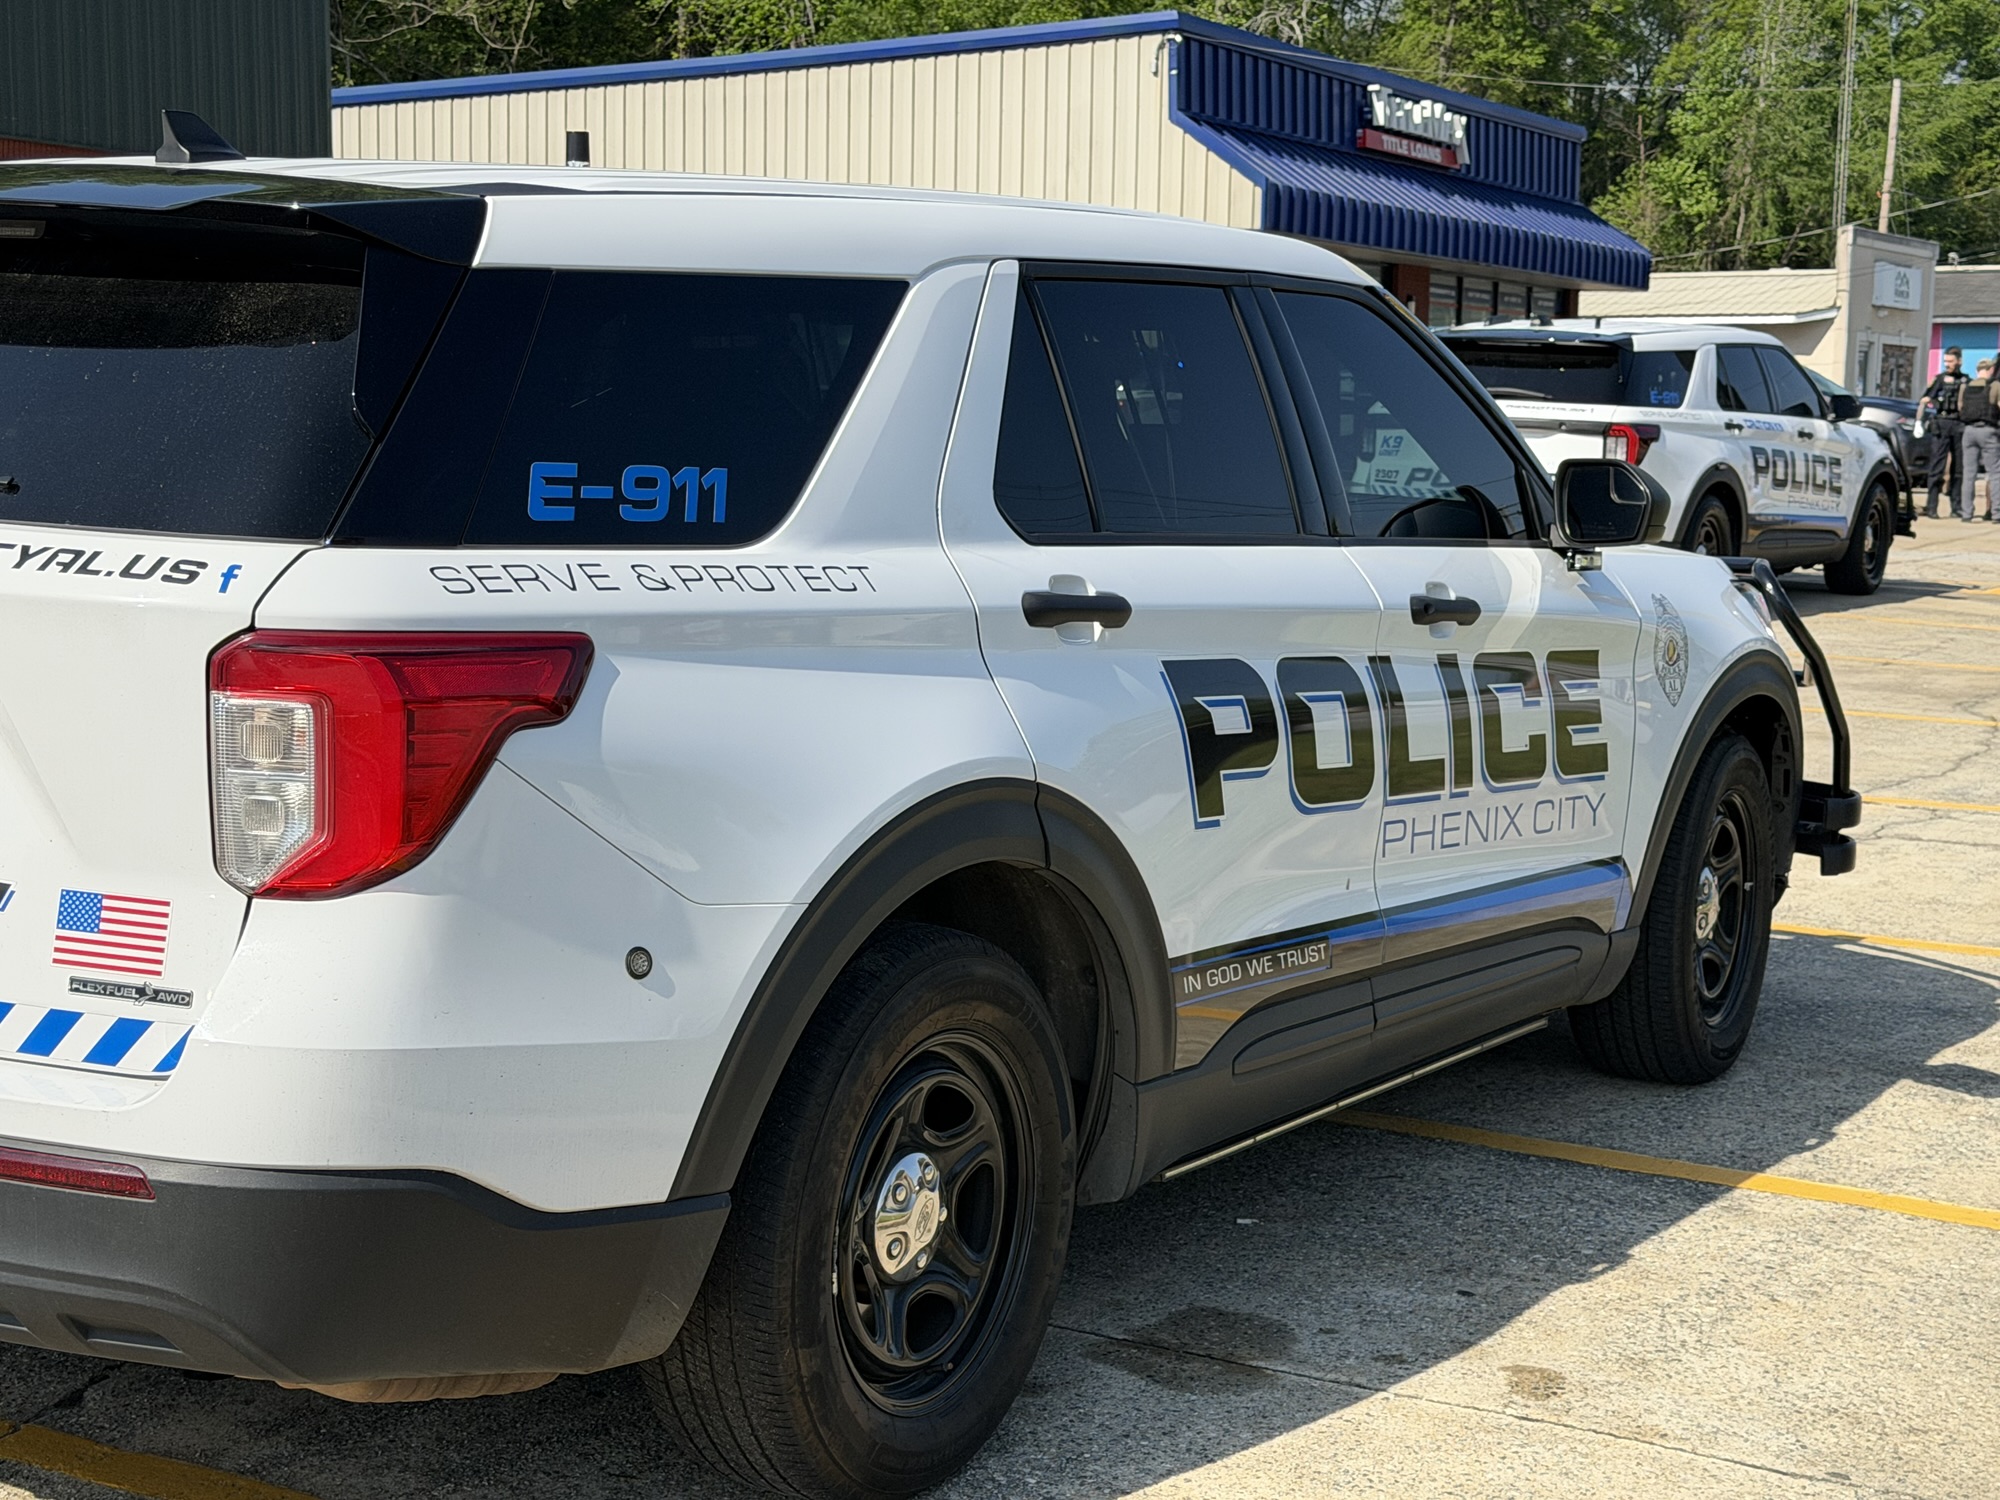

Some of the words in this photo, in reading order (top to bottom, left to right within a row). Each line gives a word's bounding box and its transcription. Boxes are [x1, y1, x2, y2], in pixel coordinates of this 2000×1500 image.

[1382, 135, 1409, 155] TITLE
[1410, 140, 1442, 163] LOANS
[1381, 435, 1404, 448] K9
[527, 461, 729, 523] E-911
[1749, 446, 1842, 498] POLICE
[429, 563, 621, 594] SERVE
[1159, 649, 1609, 829] POLICE
[1382, 803, 1523, 858] PHENIX
[1533, 793, 1606, 834] CITY
[71, 981, 105, 994] FLEX
[106, 985, 140, 998] FUEL
[157, 992, 189, 1004] AWD
[1183, 973, 1202, 994] IN
[1206, 963, 1242, 987] GOD
[1246, 955, 1273, 977] WE
[1277, 943, 1326, 969] TRUST
